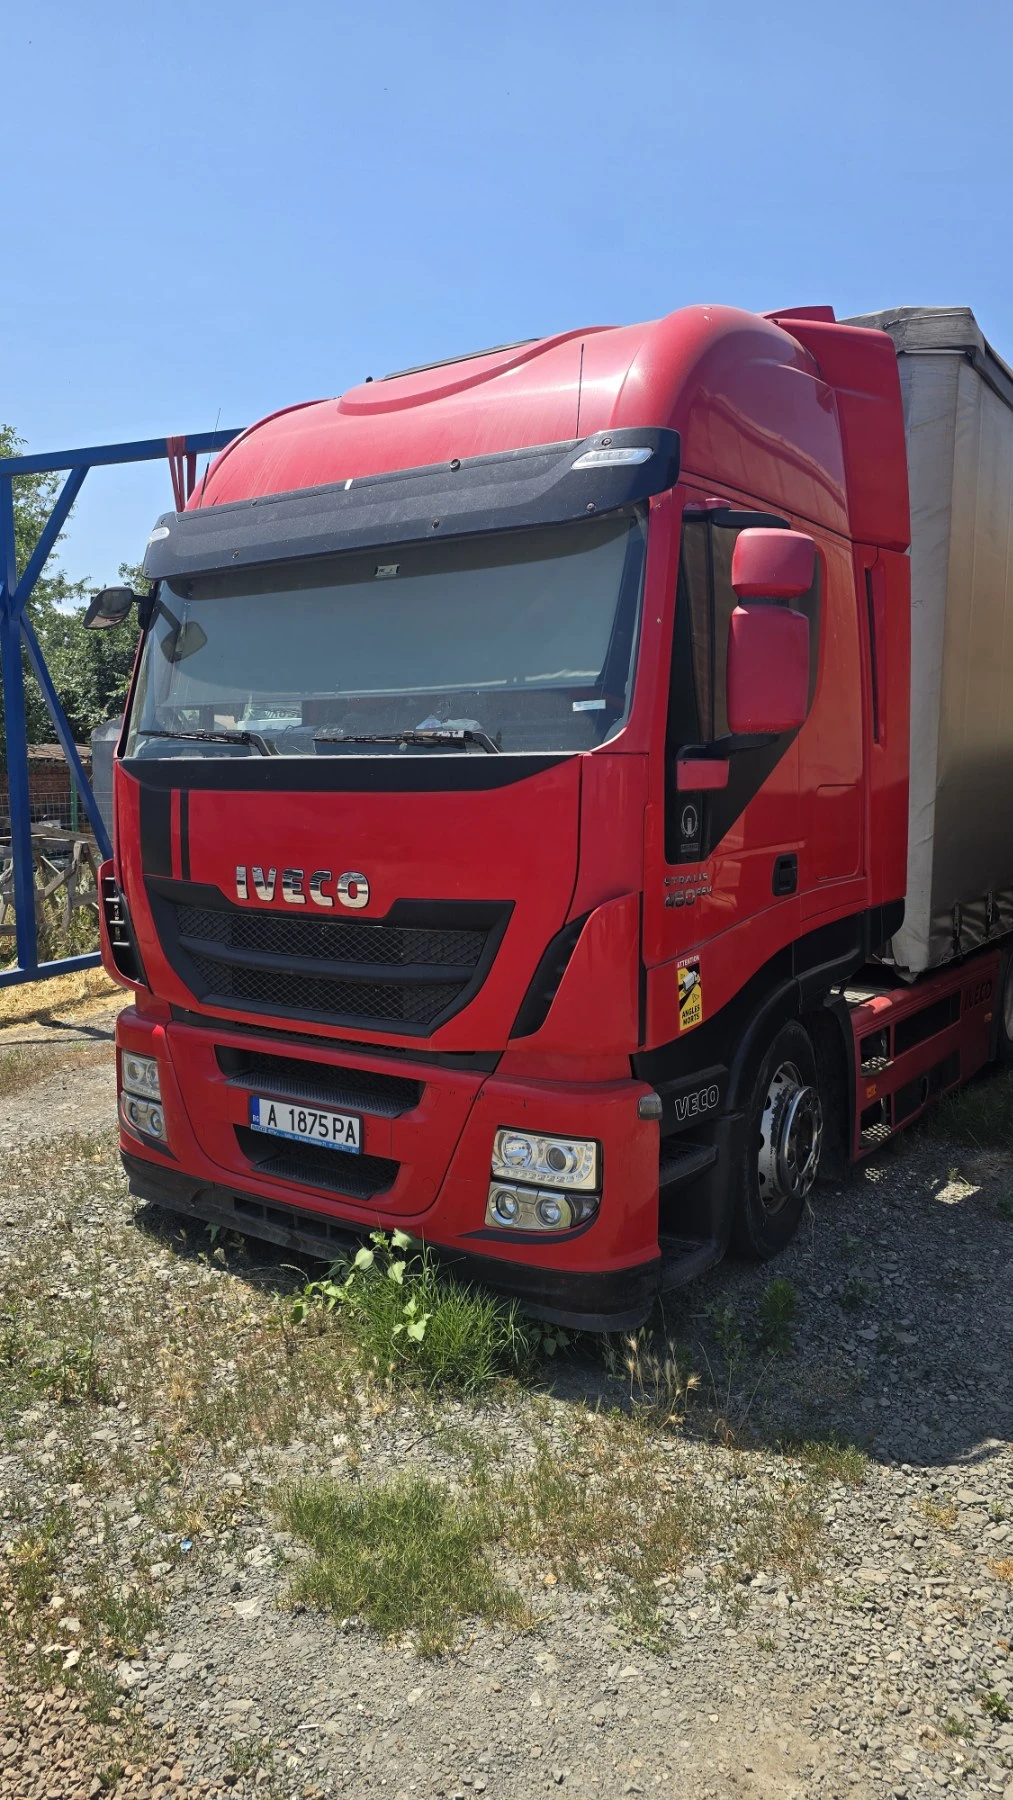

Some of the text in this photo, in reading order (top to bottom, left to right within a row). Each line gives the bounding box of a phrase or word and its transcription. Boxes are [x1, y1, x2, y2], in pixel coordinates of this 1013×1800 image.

[664, 872, 708, 886] STRALIS
[236, 865, 370, 909] IVECO
[677, 954, 700, 968] ATTENTION
[682, 1004, 700, 1019] ANGLES
[682, 1013, 700, 1026] MORTS
[267, 1103, 278, 1128] A
[288, 1108, 330, 1138] 1875
[332, 1117, 357, 1145] PA
